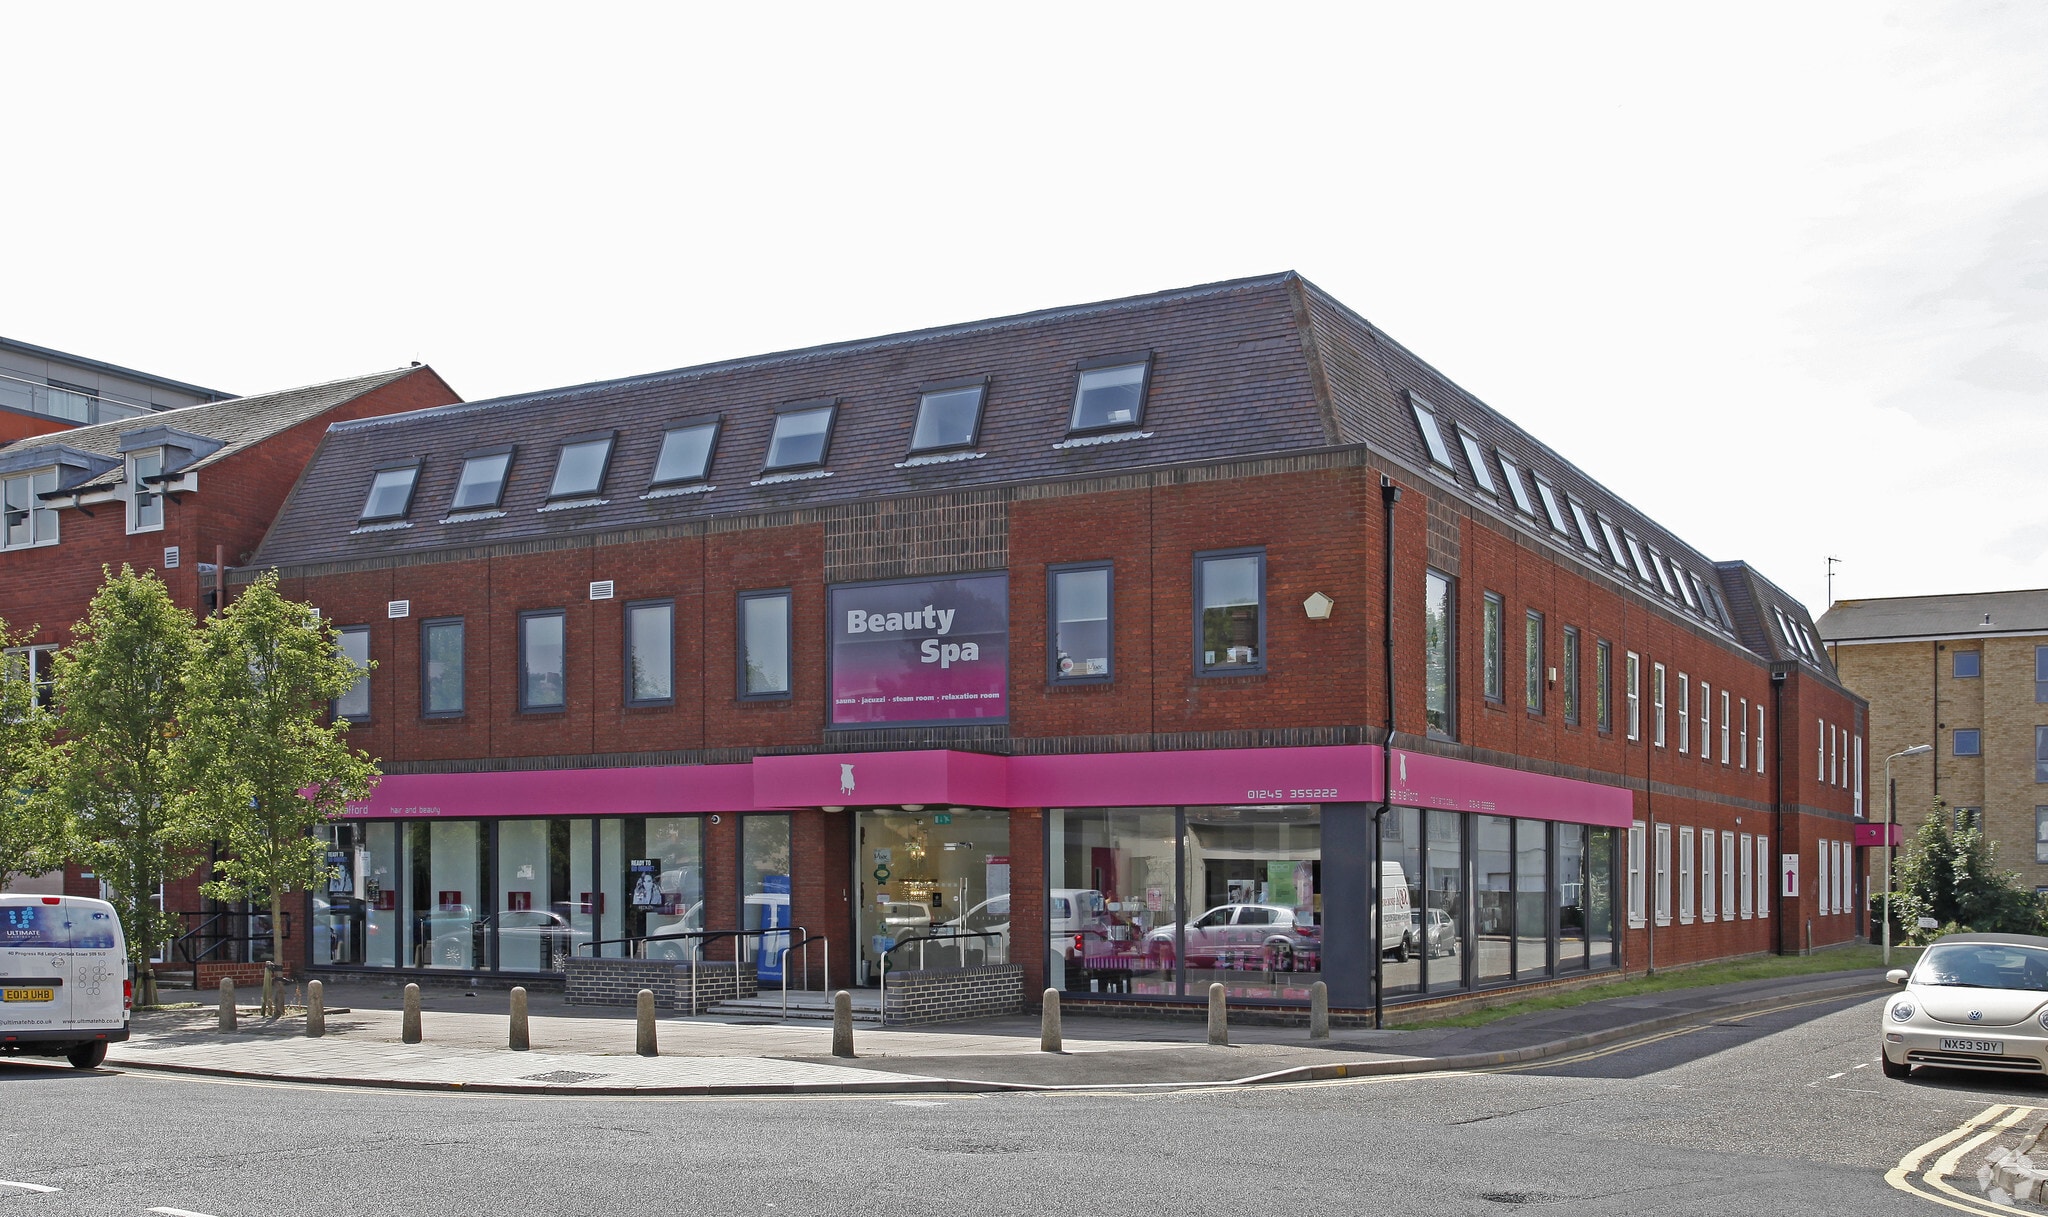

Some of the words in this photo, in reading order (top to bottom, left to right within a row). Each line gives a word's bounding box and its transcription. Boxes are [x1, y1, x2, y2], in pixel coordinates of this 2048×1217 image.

[847, 604, 956, 635] Beauty
[920, 638, 979, 669] Spa
[835, 697, 856, 705] sauna
[861, 696, 886, 705] jacuzzi
[892, 695, 914, 703] steam
[915, 694, 935, 702] room
[1247, 790, 1283, 799] 01245
[1290, 788, 1338, 798] 355222
[390, 806, 402, 814] hair
[404, 806, 417, 814] and
[419, 806, 441, 816] beauty
[31, 990, 50, 999] UHB
[1944, 1040, 1973, 1050] NX53
[1976, 1042, 1997, 1051] SDY
